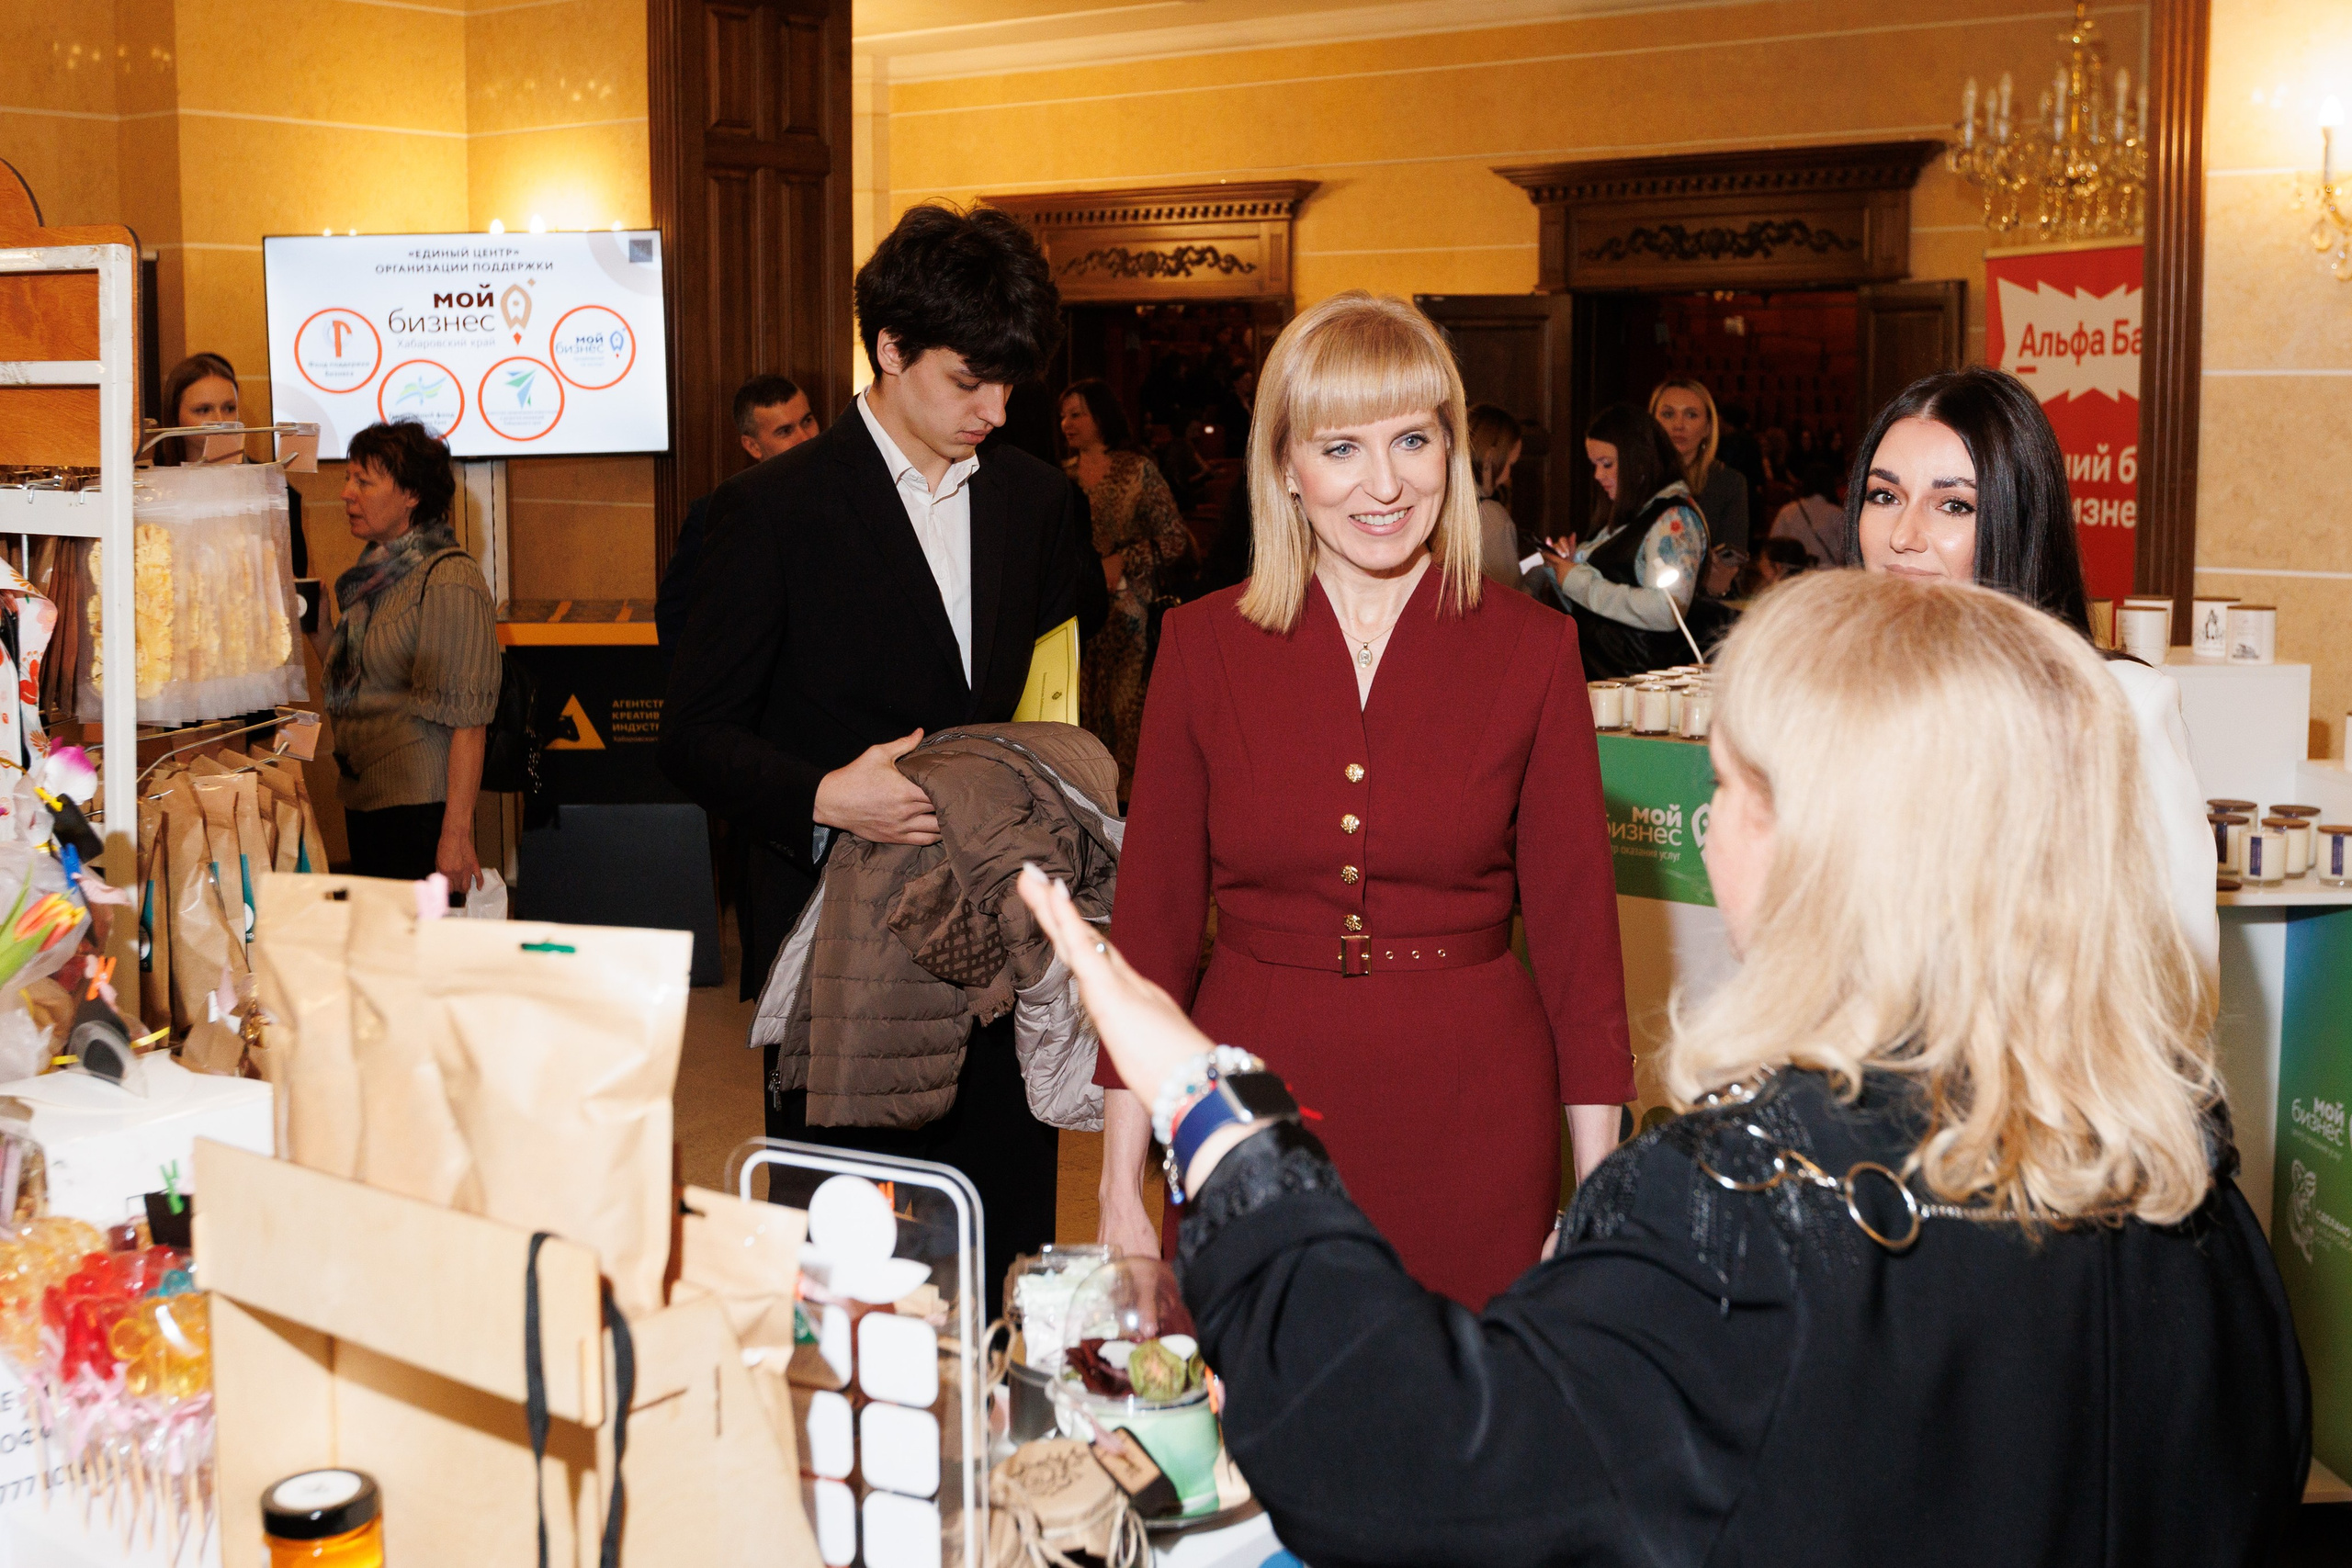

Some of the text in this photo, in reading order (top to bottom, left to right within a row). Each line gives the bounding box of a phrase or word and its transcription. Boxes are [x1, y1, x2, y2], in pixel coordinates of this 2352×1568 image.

[375, 262, 553, 274] ОРГАНИЗАЦИИ ПОДДЕРЖКИ
[434, 284, 494, 309] мой
[388, 307, 495, 333] бизнес
[397, 338, 496, 349] Хабаровский край
[575, 332, 604, 344] мой
[2018, 319, 2105, 367] Альфа
[555, 341, 605, 355] бизнес
[1632, 804, 1682, 829] мой
[1659, 851, 1680, 863] услуг
[2291, 1098, 2344, 1147] бизнес
